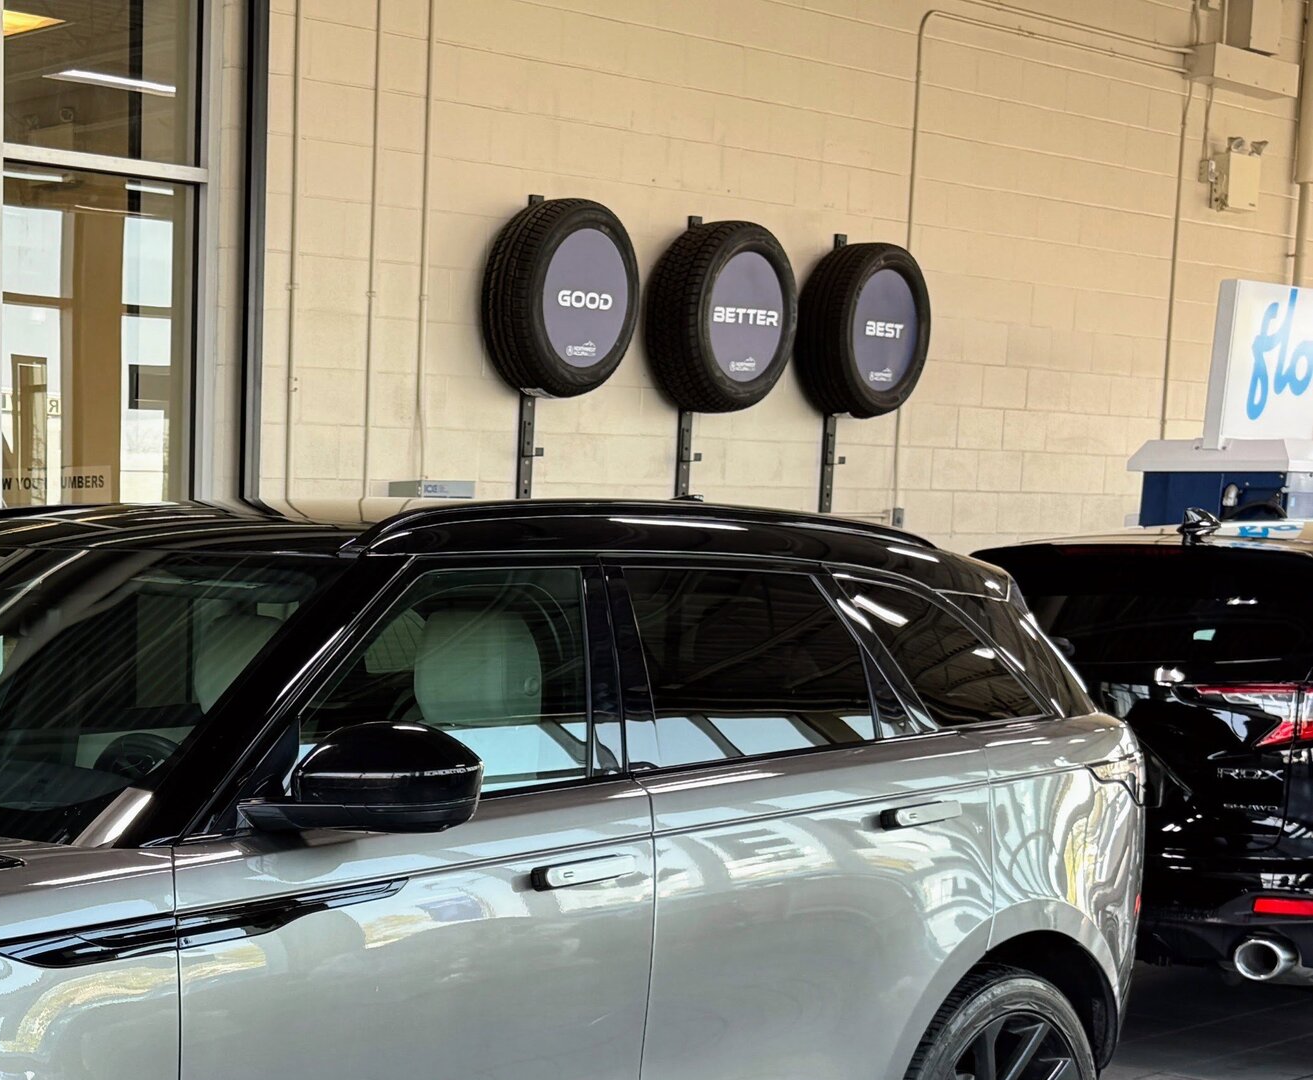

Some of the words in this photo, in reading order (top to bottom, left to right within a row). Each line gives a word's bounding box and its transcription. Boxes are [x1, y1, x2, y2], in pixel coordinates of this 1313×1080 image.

[557, 289, 613, 310] GOOD
[713, 306, 779, 327] BETTER
[865, 320, 904, 339] BEST
[16, 477, 49, 491] YOU
[51, 475, 105, 490] UMBERS
[1217, 767, 1284, 782] RDX
